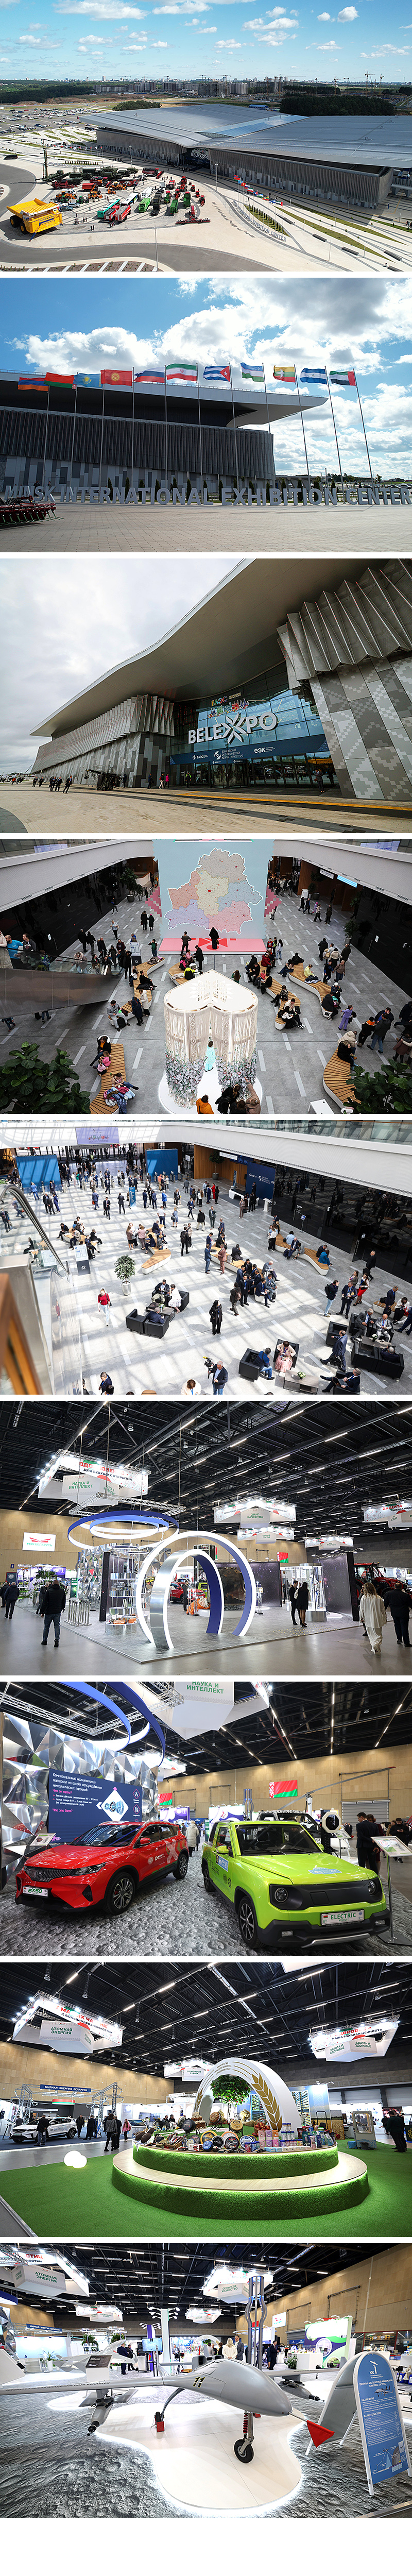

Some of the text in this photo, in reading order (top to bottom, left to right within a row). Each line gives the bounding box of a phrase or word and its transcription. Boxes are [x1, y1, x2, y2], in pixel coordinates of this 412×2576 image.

[5, 485, 412, 506] MINSK INTERNATIONAL EXHIBITION CENTER
[211, 696, 228, 706] ЕАЭС
[188, 712, 277, 744] BELEXPO
[186, 1685, 224, 1694] ИНТЕЛЛЕКТ
[331, 1912, 356, 1920] ELECTRIC
[61, 2007, 85, 2020] МАЫХ
[65, 2014, 85, 2024] БОЛЬШИМ
[330, 2046, 345, 2055] ЗДОРОВЬЕ
[35, 2271, 57, 2280] АТОМНАЯ
[36, 2275, 57, 2283] ЭНЕРГИЯ
[193, 2376, 205, 2388] 11
